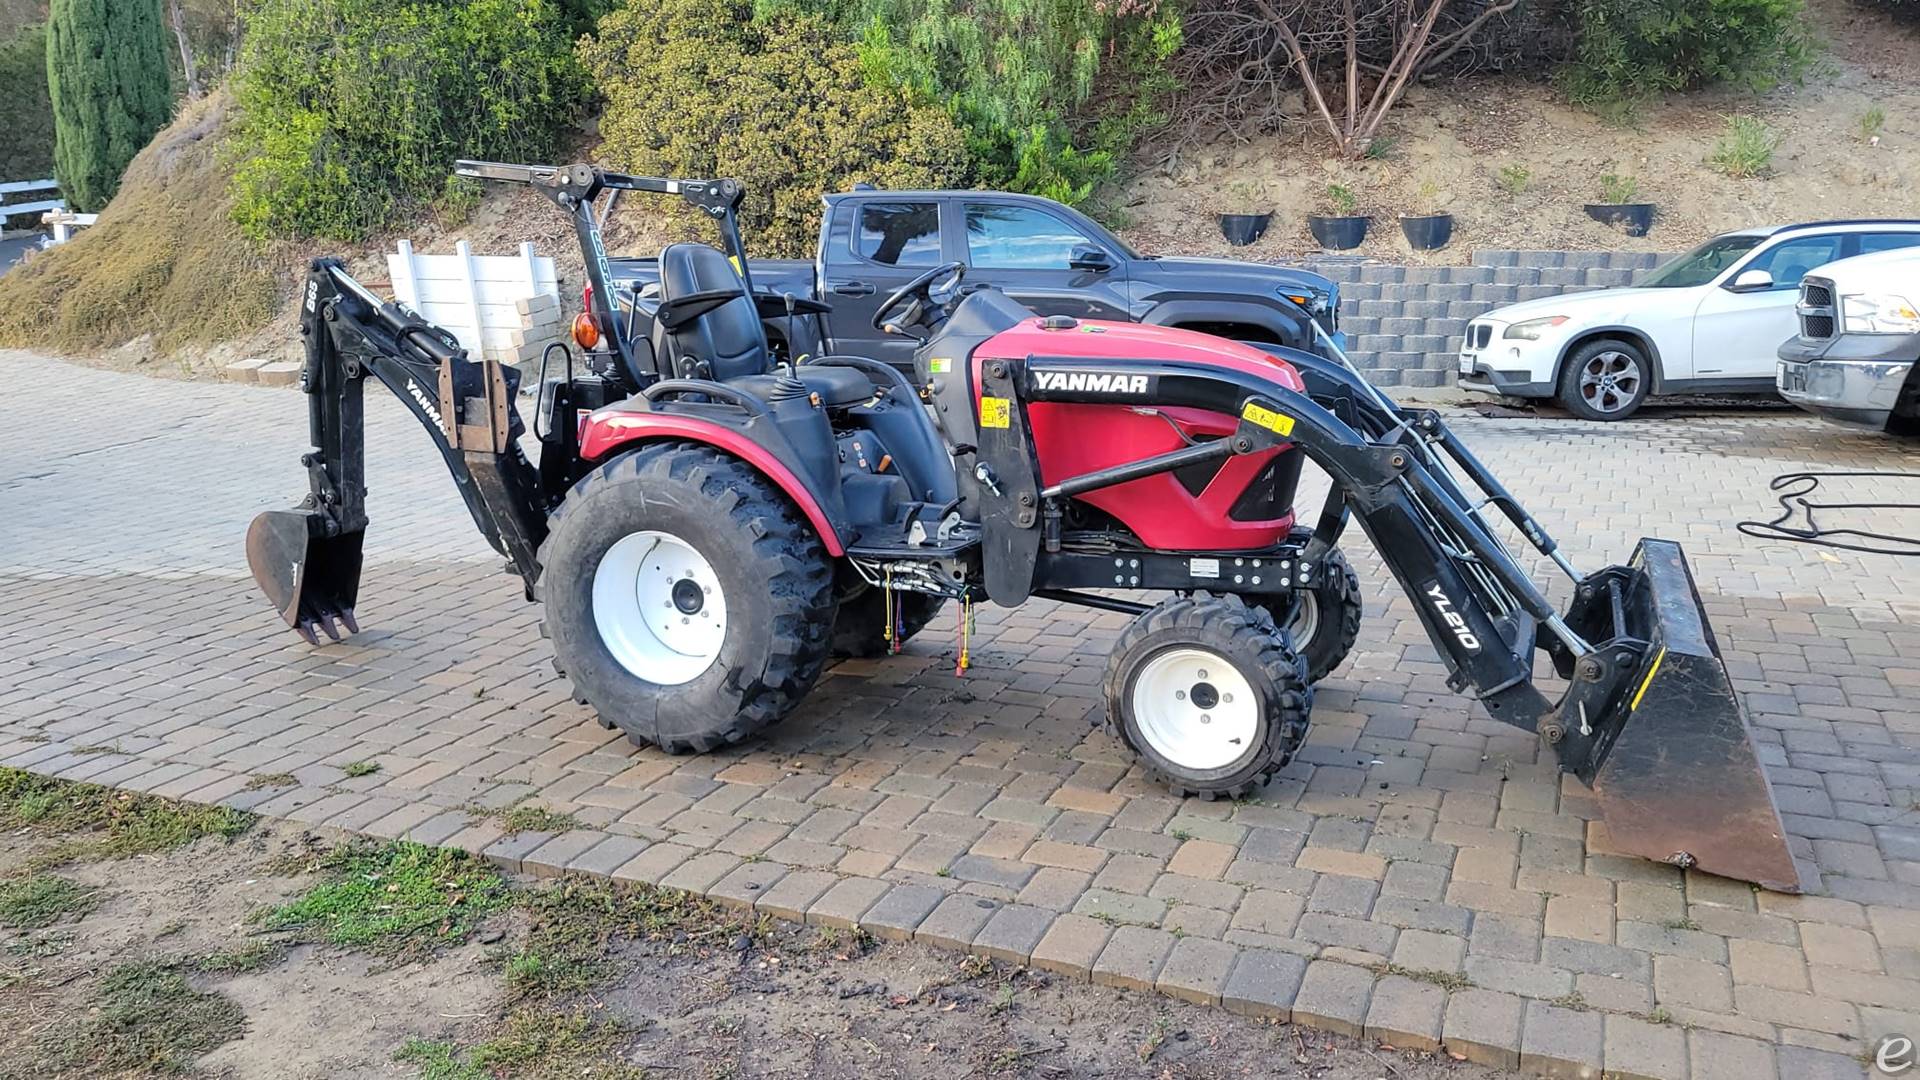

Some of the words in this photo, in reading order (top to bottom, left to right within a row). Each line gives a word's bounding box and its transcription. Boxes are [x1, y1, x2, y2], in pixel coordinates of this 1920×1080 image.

[306, 280, 318, 313] B65
[592, 230, 619, 310] 698
[406, 377, 449, 438] YANMA
[1034, 371, 1148, 393] YANMAR
[1427, 584, 1480, 649] YL210
